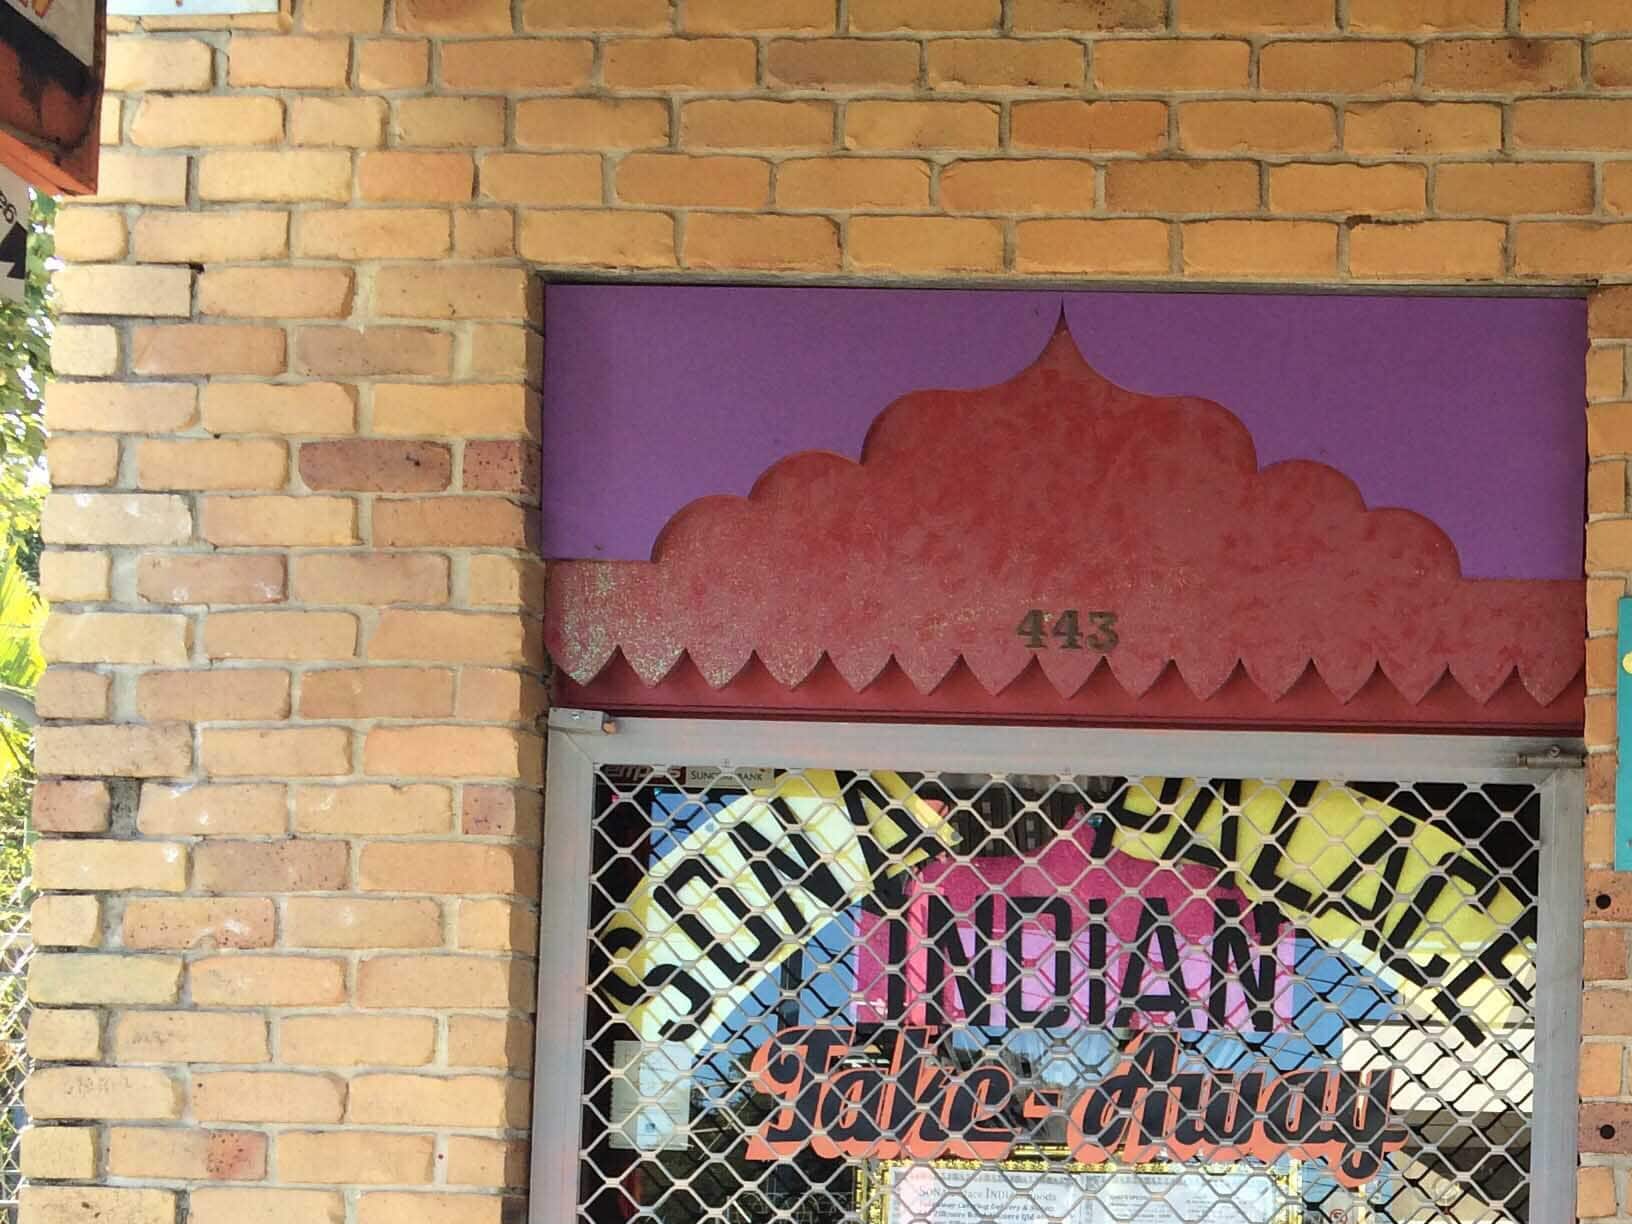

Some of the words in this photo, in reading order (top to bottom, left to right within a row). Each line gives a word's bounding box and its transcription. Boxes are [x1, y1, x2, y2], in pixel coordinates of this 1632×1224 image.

[1016, 609, 1120, 652] 443
[598, 770, 946, 1042] SONA
[1090, 776, 1538, 1048] PALACE
[886, 893, 1280, 1033] INDIAN
